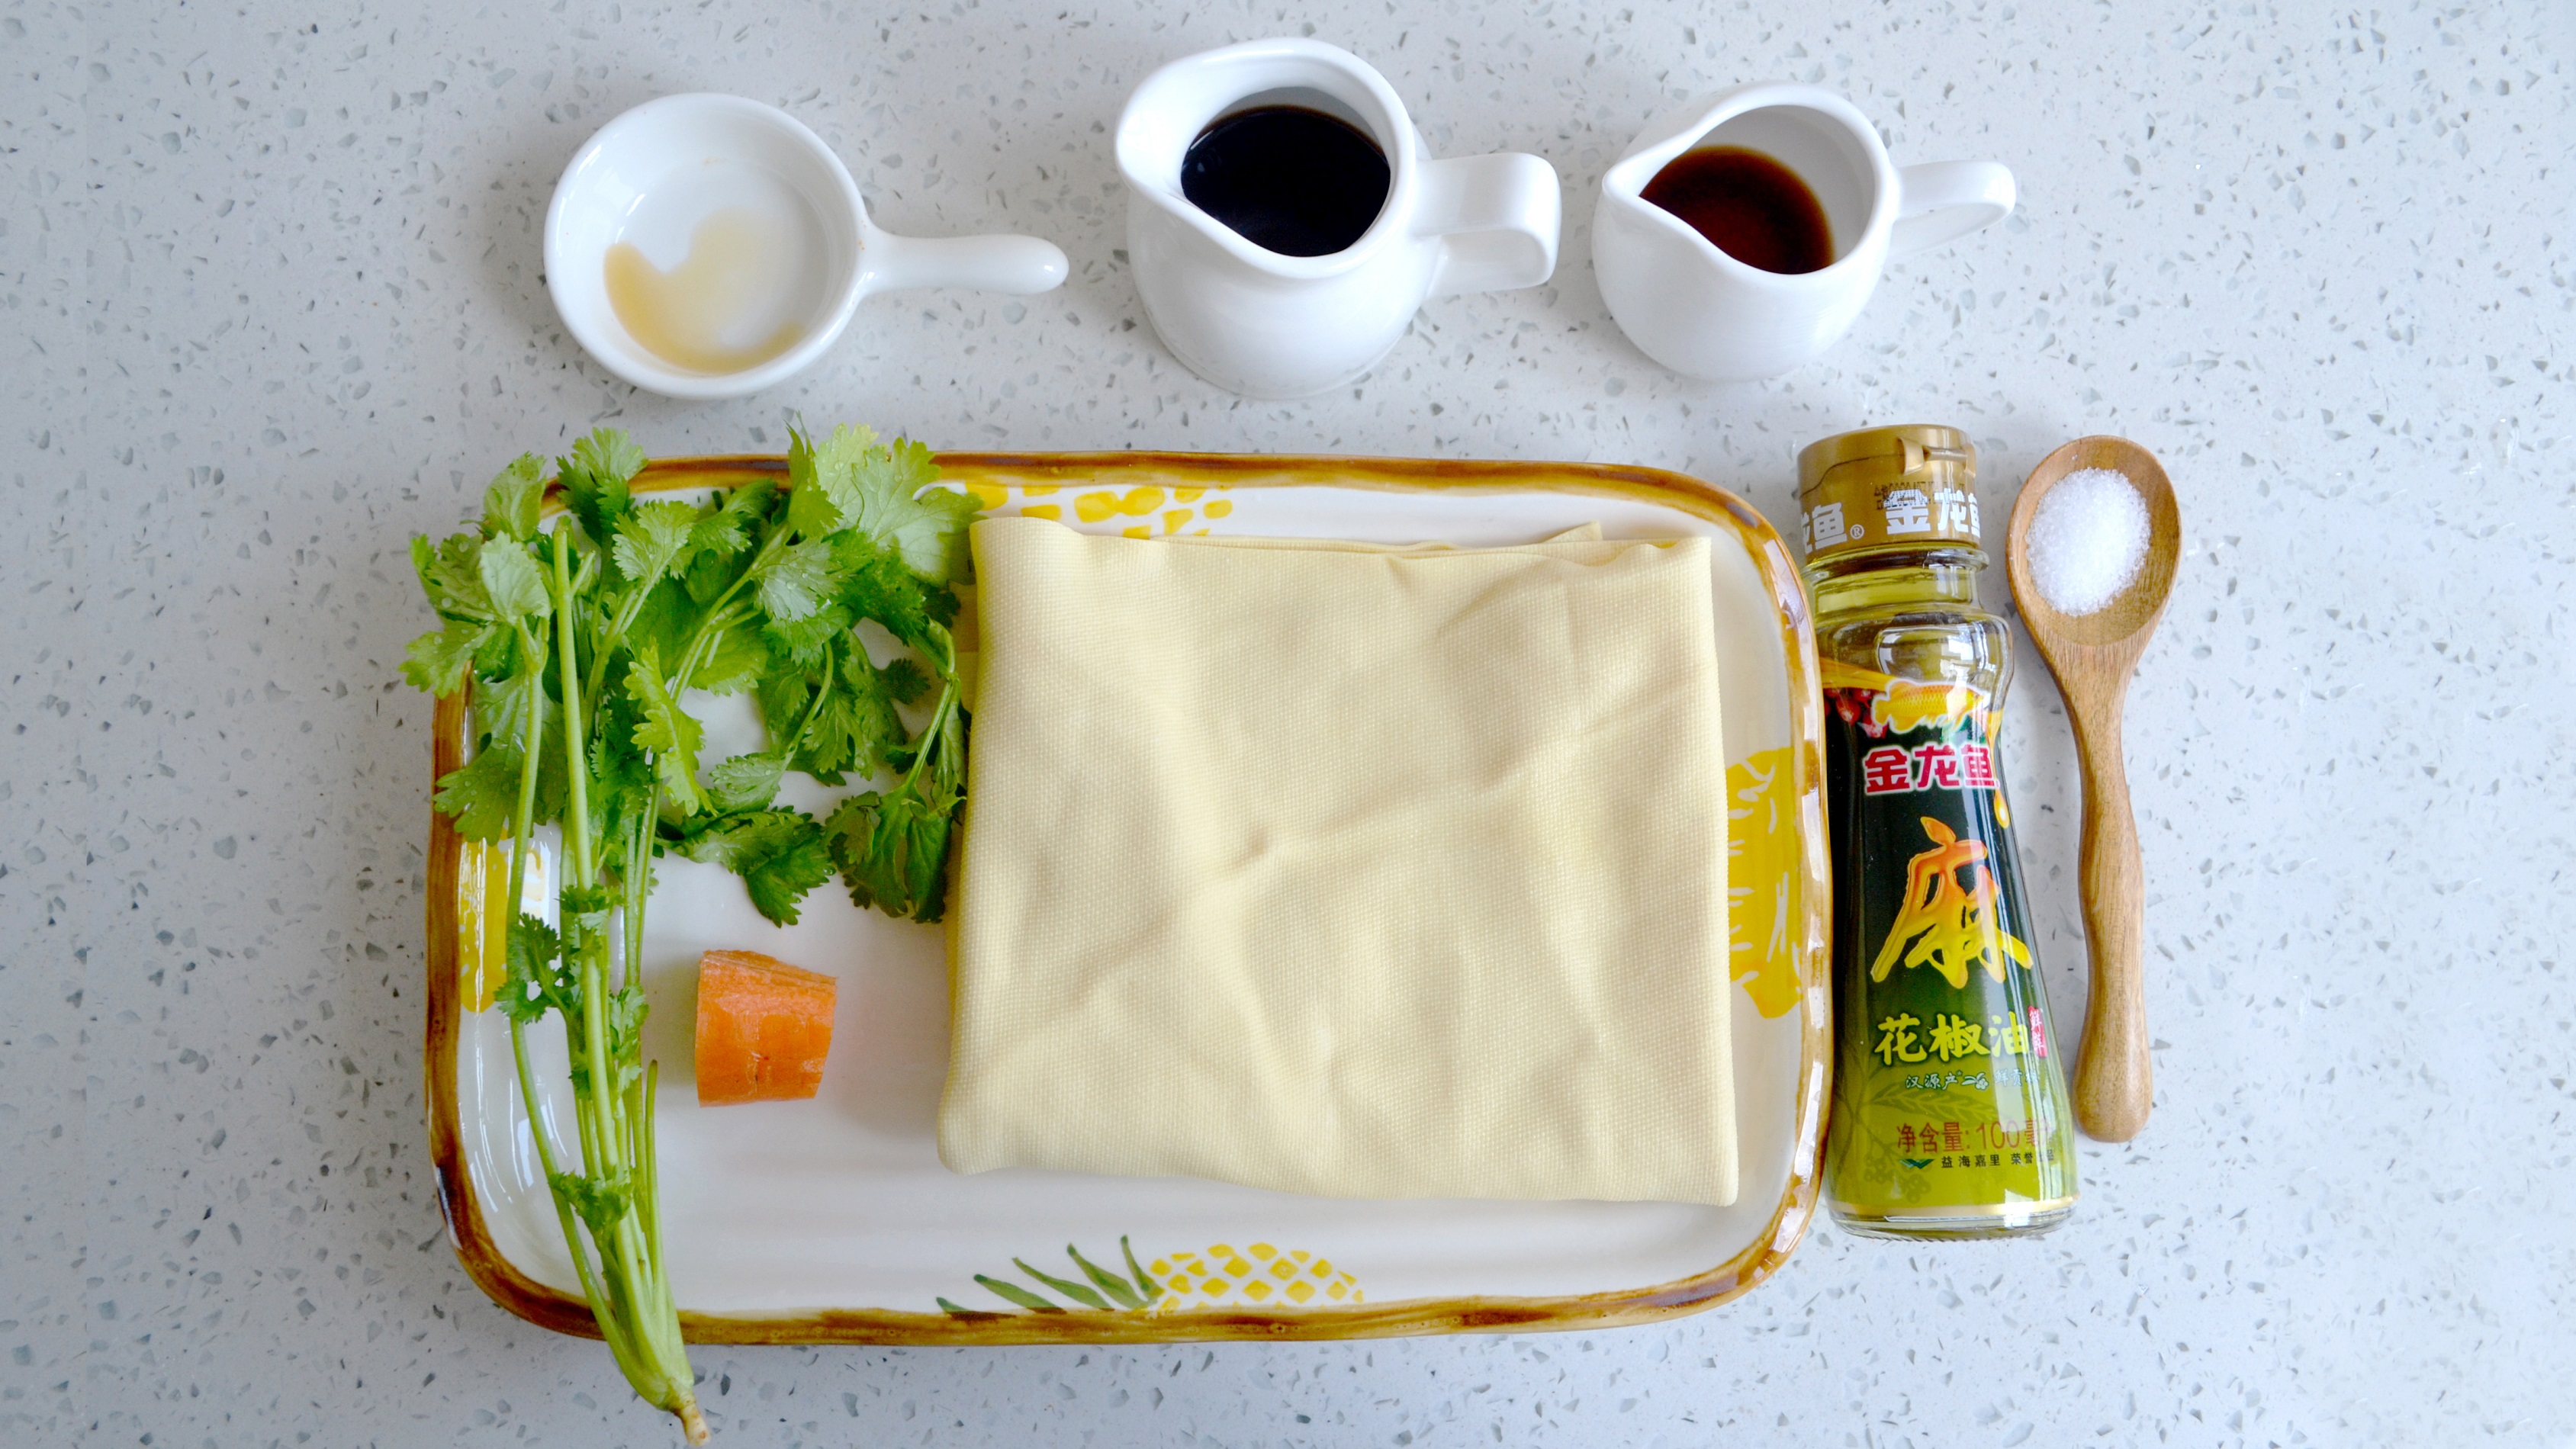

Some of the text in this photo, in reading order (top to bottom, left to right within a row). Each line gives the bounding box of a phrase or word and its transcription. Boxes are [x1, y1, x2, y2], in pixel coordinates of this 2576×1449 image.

[1865, 744, 1999, 795] 金龙鱼
[1873, 1011, 2029, 1065] 花椒油
[1941, 1153, 2002, 1168] 益海嘉里
